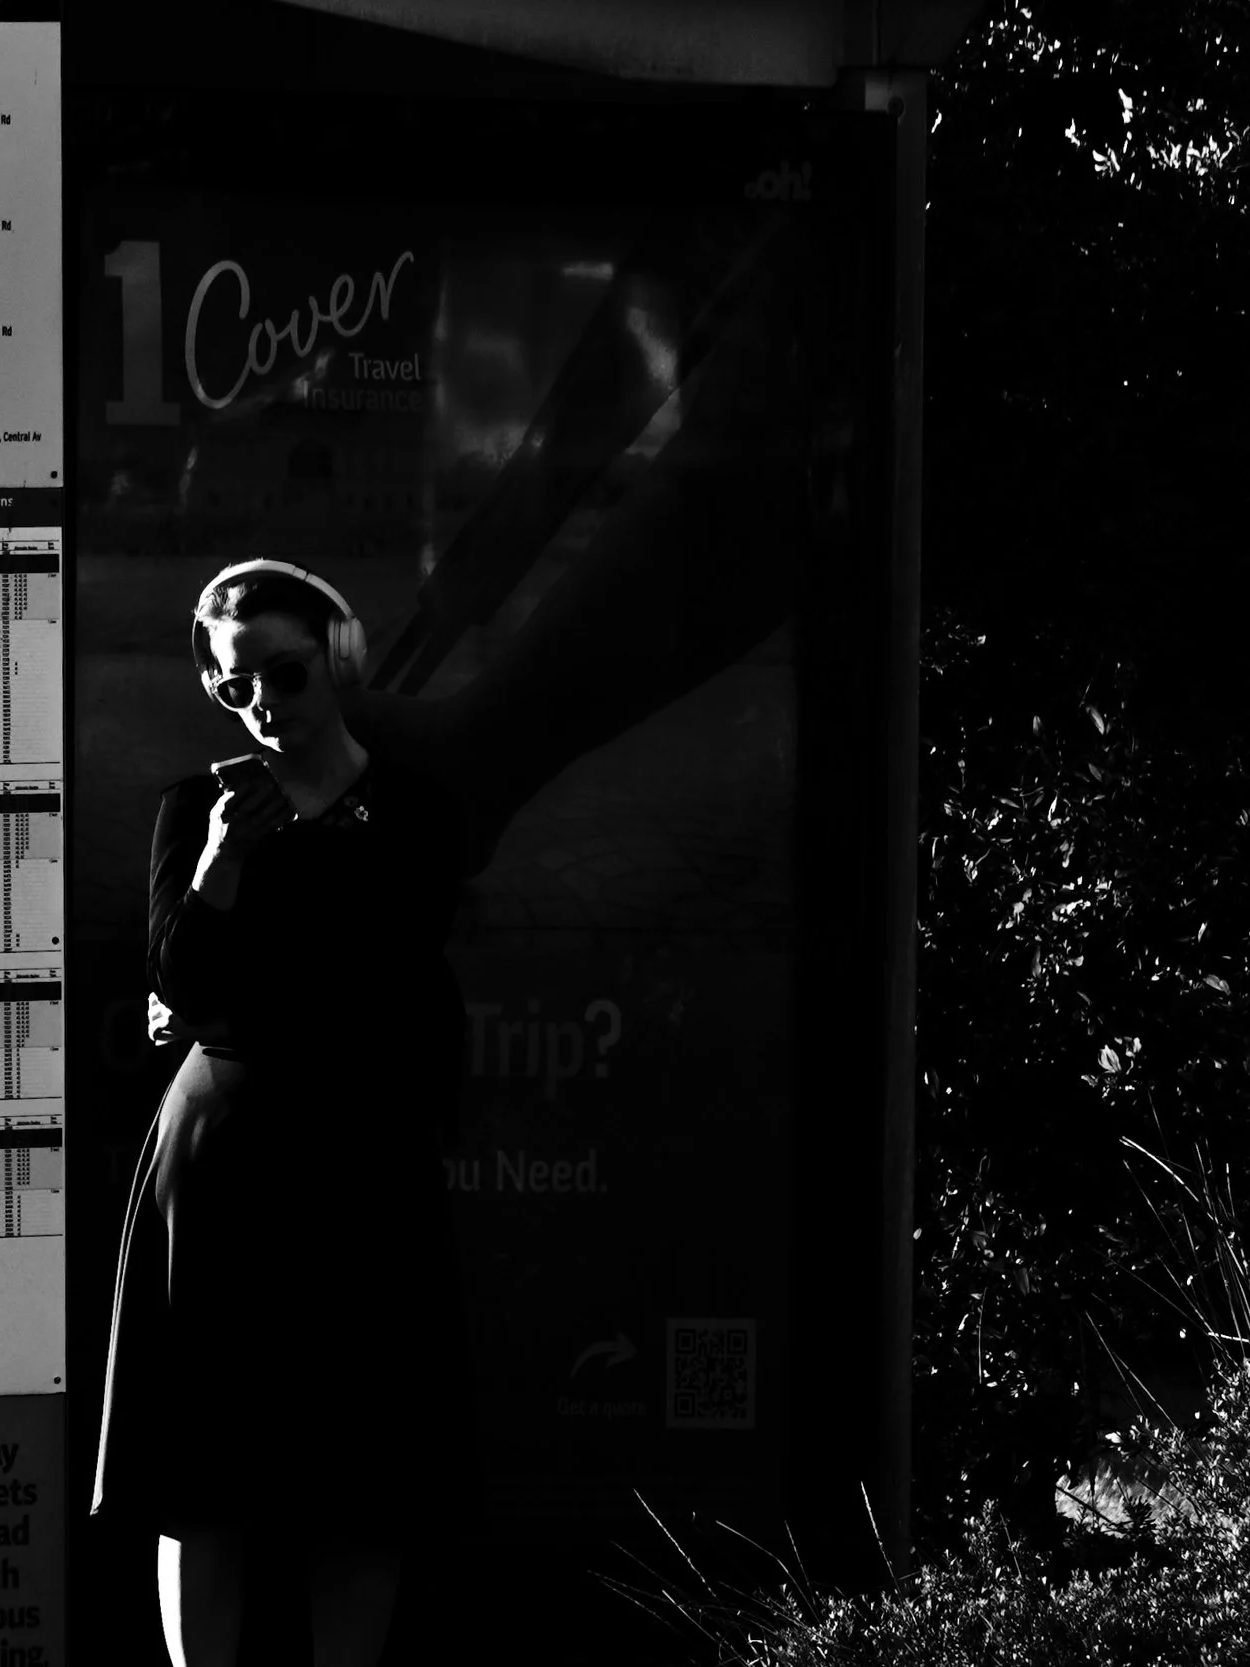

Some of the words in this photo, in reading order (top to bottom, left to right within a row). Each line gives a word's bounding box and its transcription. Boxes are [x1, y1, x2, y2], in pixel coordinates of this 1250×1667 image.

[1, 115, 11, 125] Rd
[1, 221, 12, 231] Rd
[2, 326, 12, 337] Rd
[104, 239, 181, 426] 1
[184, 250, 415, 409] Cover
[348, 352, 422, 381] Travel
[302, 380, 423, 412] Insurance
[3, 431, 31, 442] Central
[32, 432, 42, 442] Av
[463, 997, 622, 1101] Trip?
[441, 1157, 481, 1191] ou
[497, 1148, 608, 1192] Need.
[556, 1396, 586, 1416] Get
